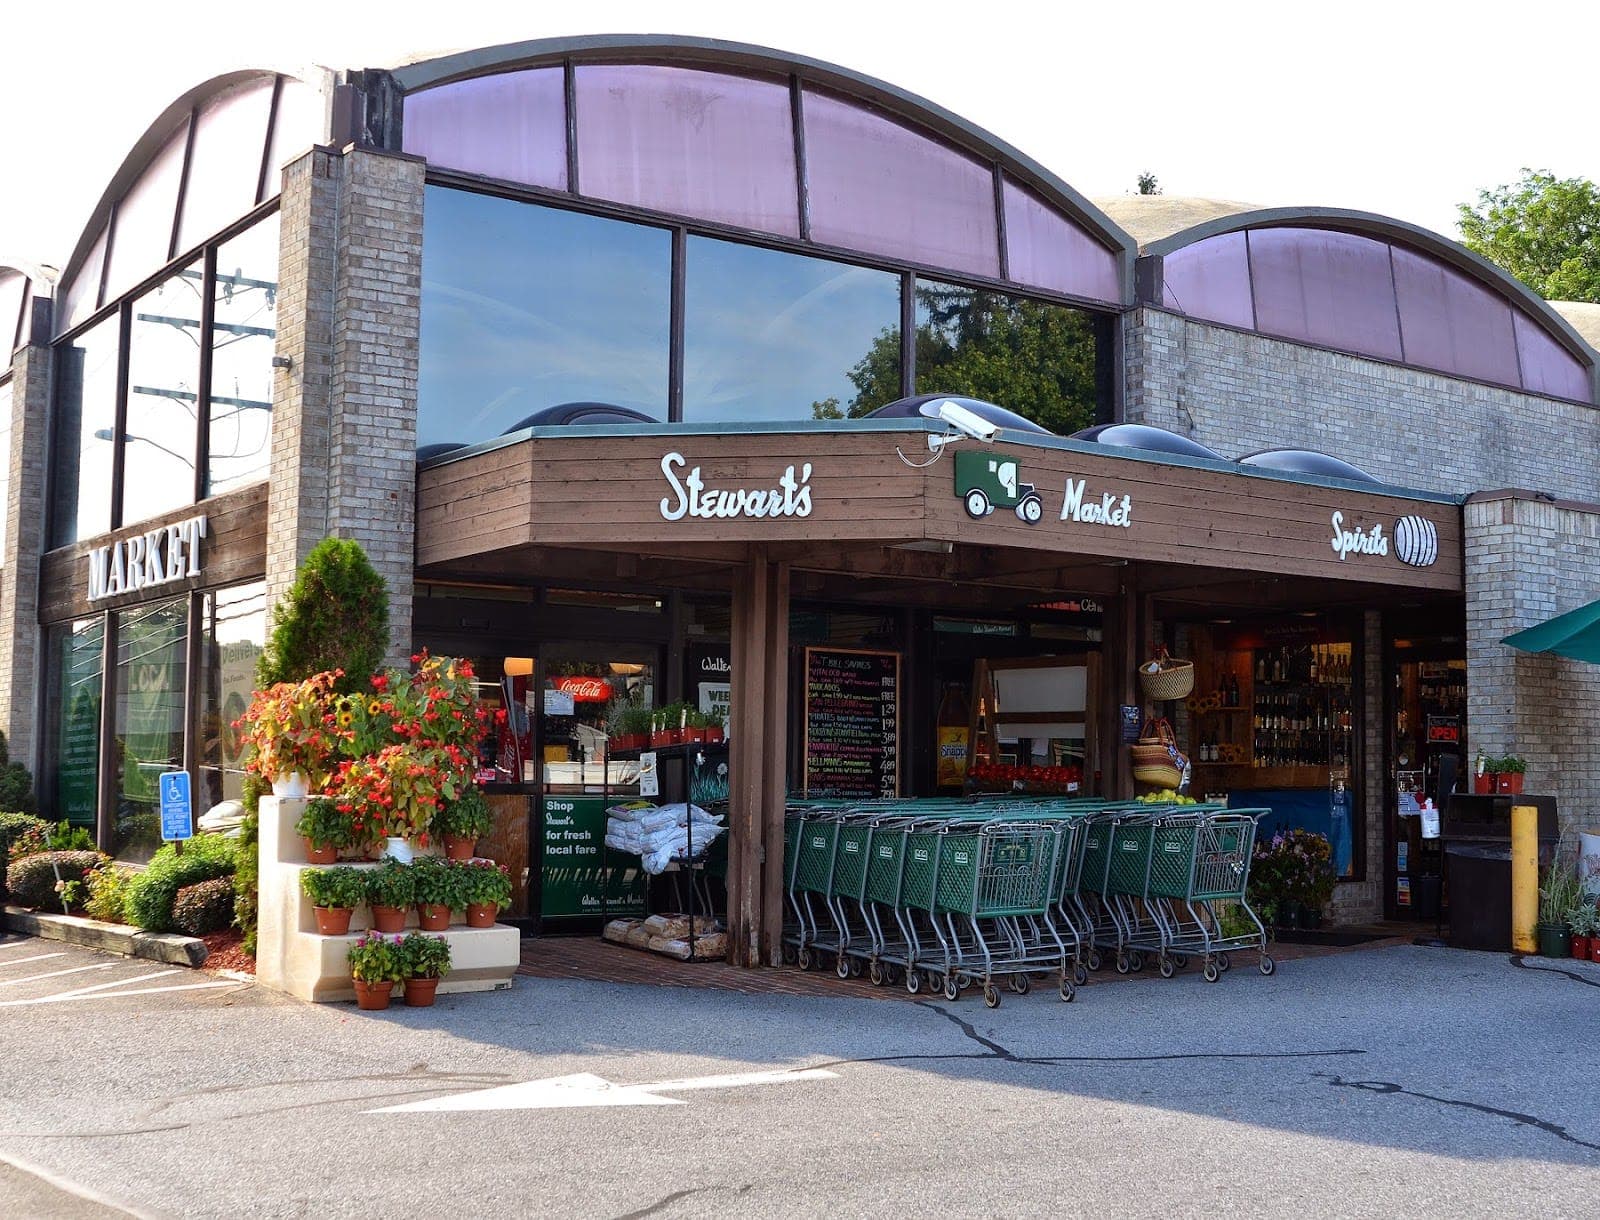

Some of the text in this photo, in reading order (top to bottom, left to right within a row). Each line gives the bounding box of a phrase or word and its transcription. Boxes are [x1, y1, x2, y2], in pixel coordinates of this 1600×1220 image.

[660, 452, 812, 521] Stewart's
[1060, 477, 1132, 528] Market
[1331, 510, 1388, 561] Spirits
[86, 514, 208, 602] MARKET
[708, 690, 731, 702] WEE
[1429, 726, 1457, 740] OPEN
[546, 800, 574, 813] Shop
[545, 830, 592, 840] for fresh
[545, 844, 597, 854] local fare
